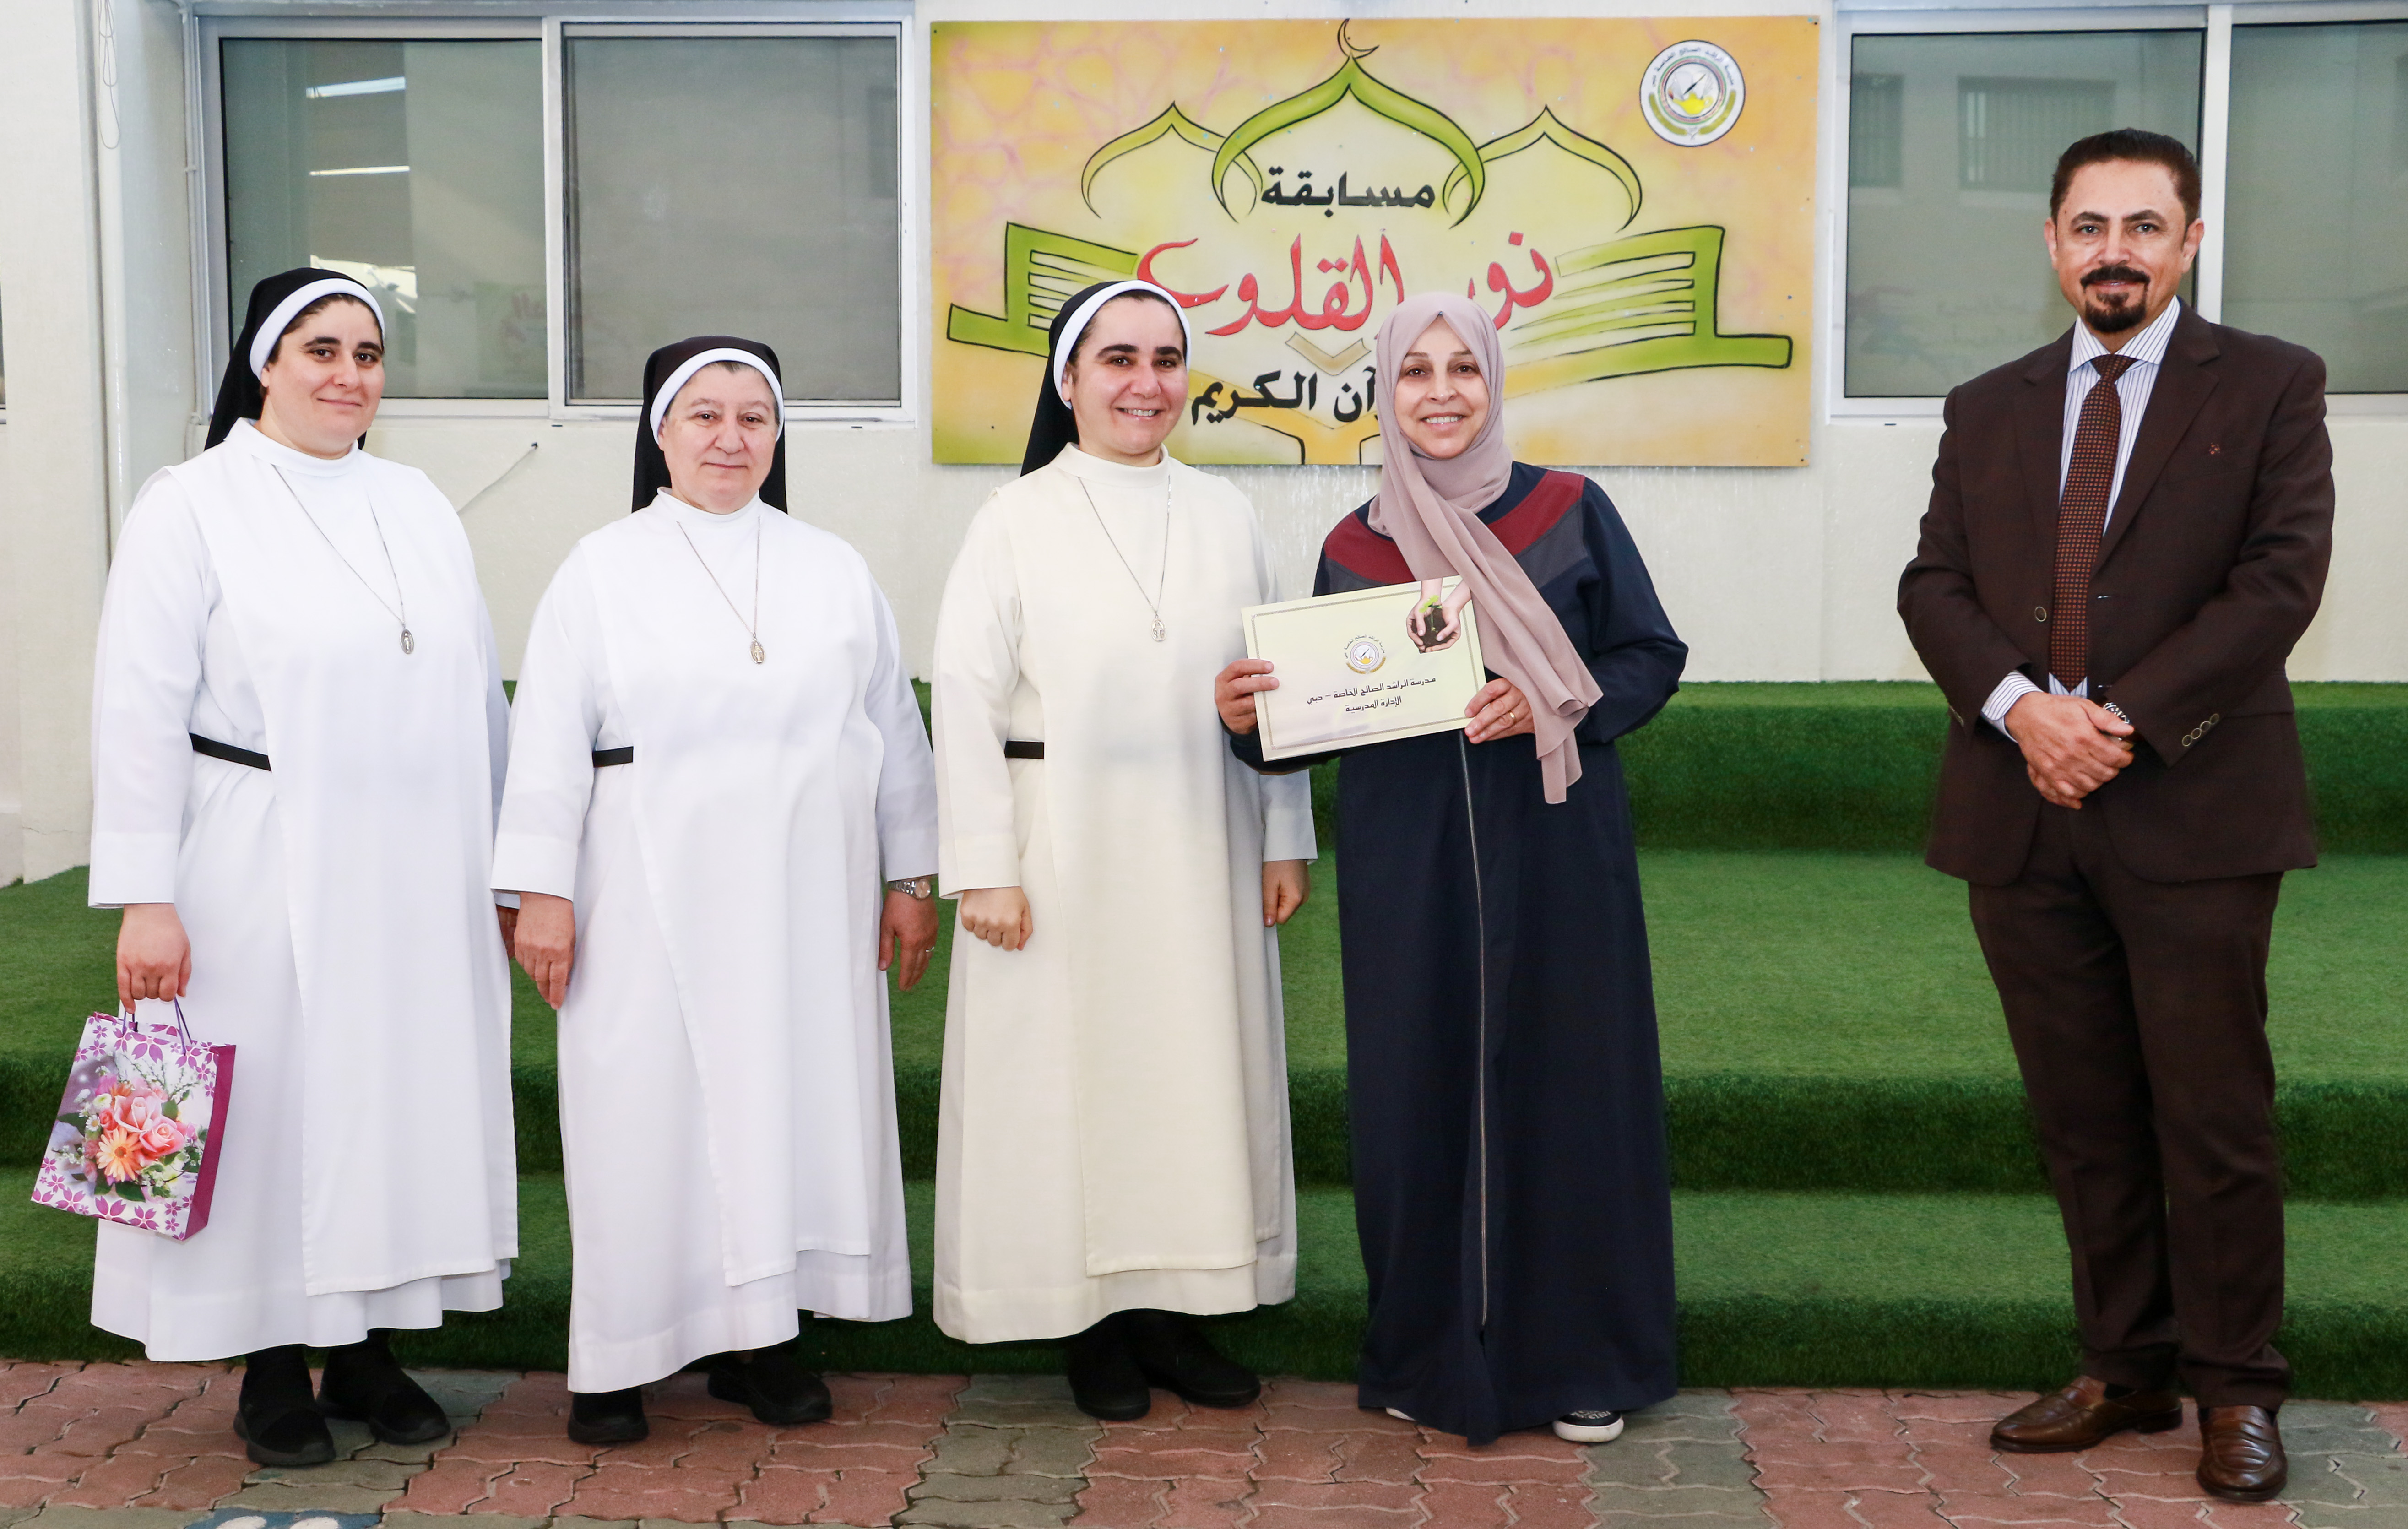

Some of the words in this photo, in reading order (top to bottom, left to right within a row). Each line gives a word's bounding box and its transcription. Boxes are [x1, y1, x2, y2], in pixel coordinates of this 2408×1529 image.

[1261, 166, 1436, 218] مسابقة
[1468, 230, 1554, 331] نو
[1191, 369, 1318, 426] الكريم
[1386, 679, 1408, 690] الراشد
[1410, 677, 1436, 686] مدرسة
[1334, 687, 1358, 698] الخاصة
[1360, 683, 1384, 696] الصالح
[1307, 696, 1323, 706] دبي
[1345, 699, 1379, 714] المدرسية
[1381, 695, 1402, 707] الإدارة
